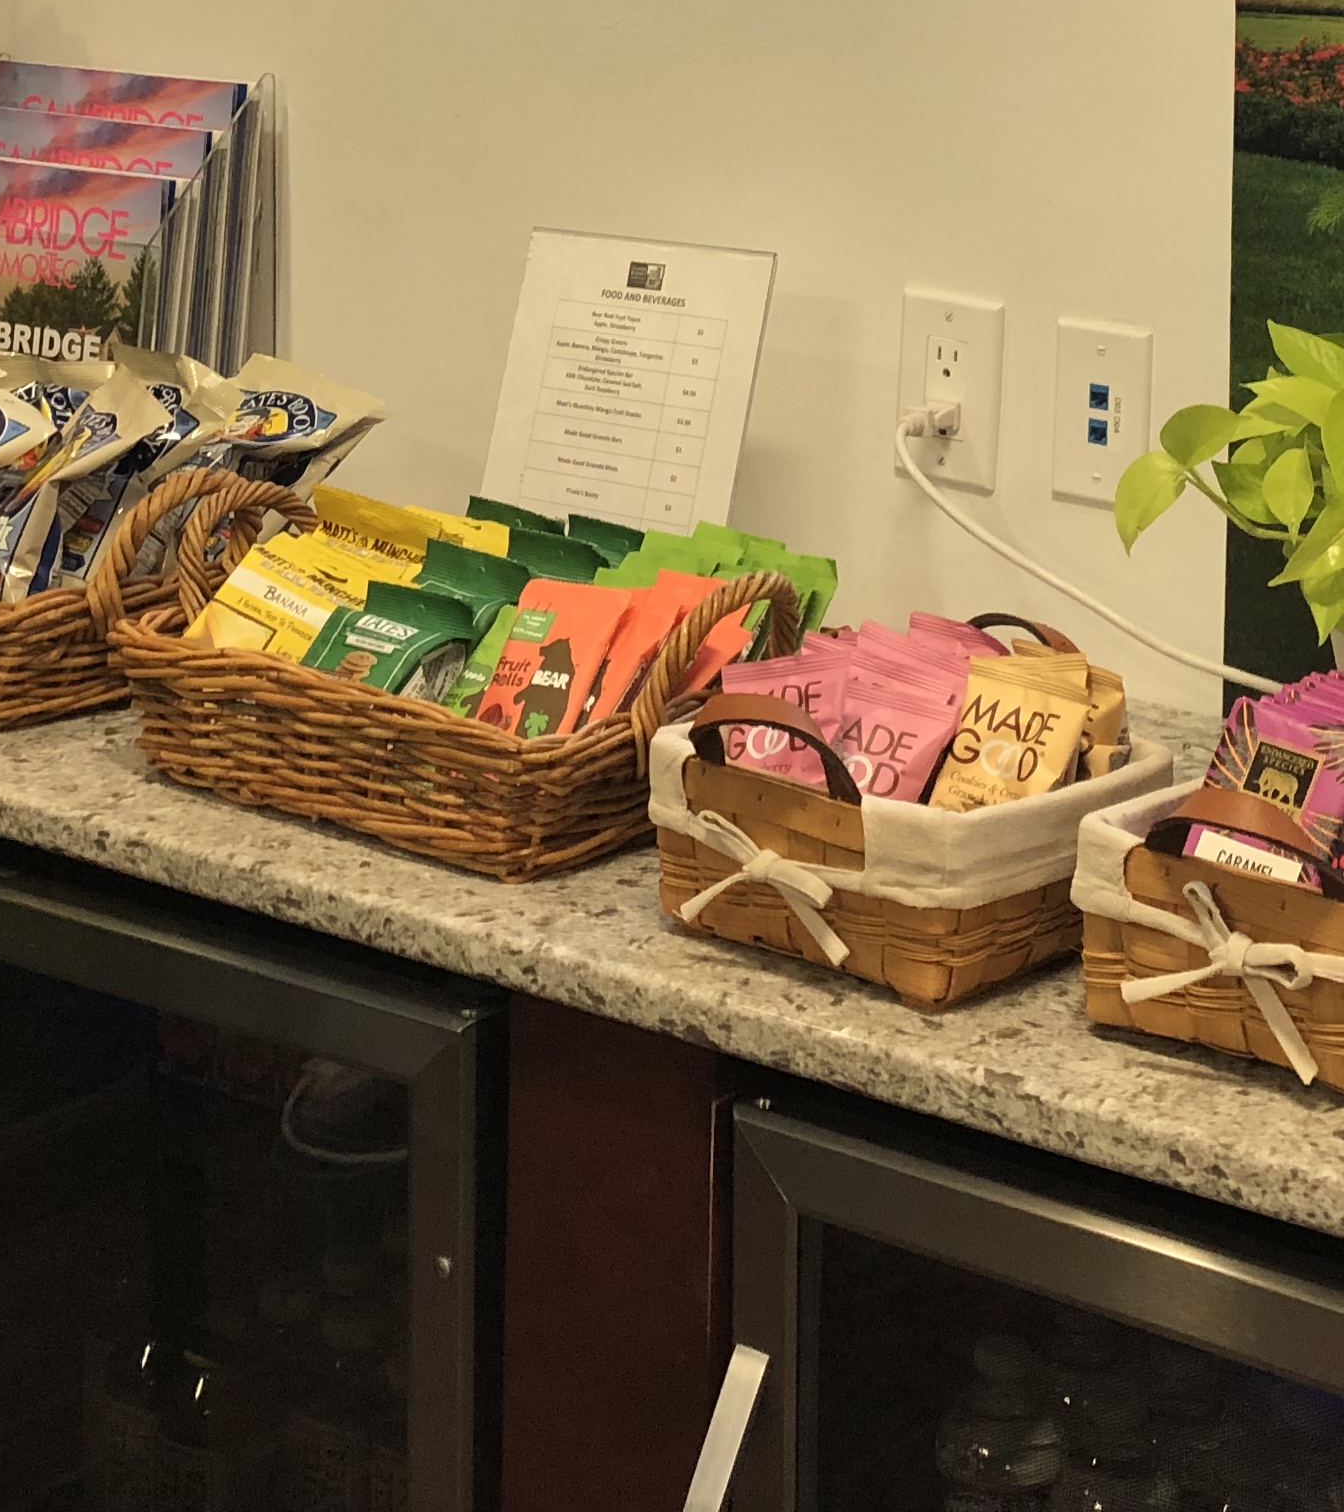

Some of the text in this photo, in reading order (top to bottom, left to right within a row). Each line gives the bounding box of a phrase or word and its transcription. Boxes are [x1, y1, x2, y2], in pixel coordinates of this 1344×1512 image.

[601, 289, 686, 308] FOOD AND BEVERAGES
[263, 585, 308, 618] BANANA
[499, 656, 532, 672] Fruit
[492, 671, 524, 687] Rolls
[531, 669, 570, 690] BEAR
[961, 694, 1062, 747] MADE
[842, 717, 919, 765] ADE
[950, 728, 1039, 782] GOOD
[950, 771, 987, 790] Cookies
